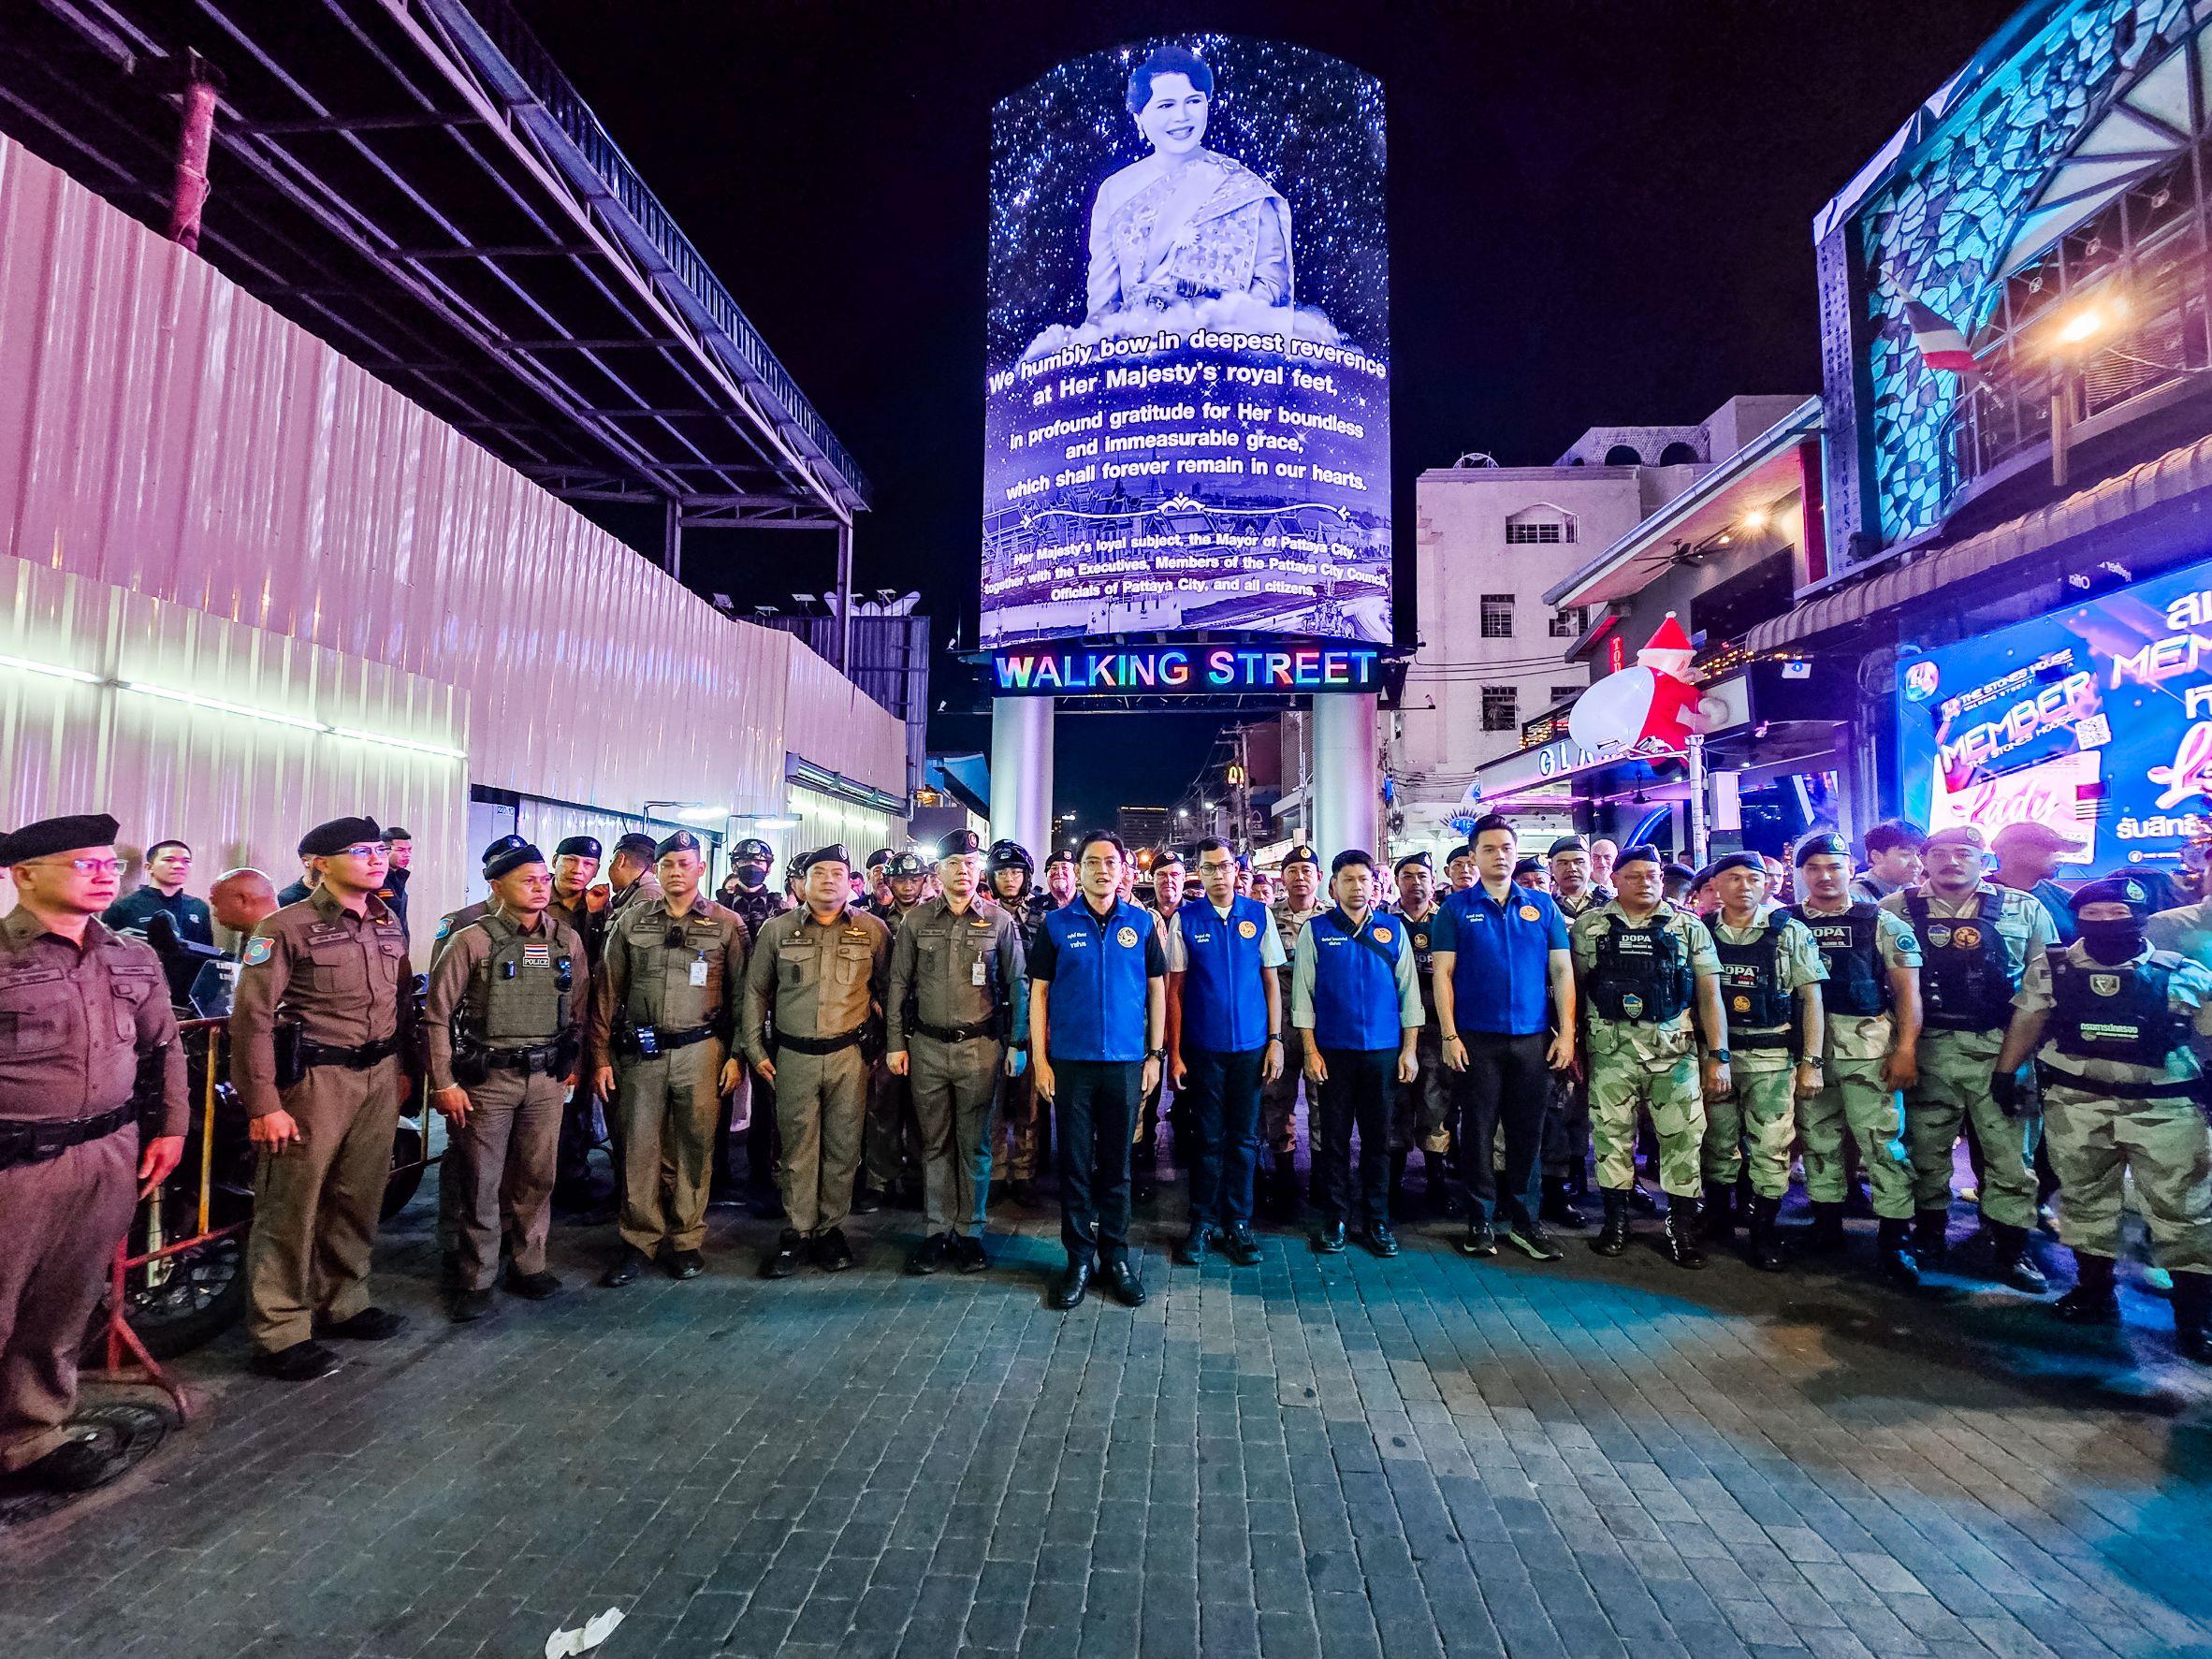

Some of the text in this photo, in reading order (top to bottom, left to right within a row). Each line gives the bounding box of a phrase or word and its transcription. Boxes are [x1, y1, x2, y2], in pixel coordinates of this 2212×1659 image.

[988, 328, 1388, 395] We humbly bow in deepest reverence
[1032, 362, 1338, 406] at Her Majesty's royal feet,
[1010, 402, 1364, 450] in profound gratitude for Her boundless
[1065, 429, 1304, 459] and immeasurable grace,
[1006, 456, 1368, 501] which shall forever remain in our hearts.
[1013, 533, 1358, 567] Her Majesty's loyal subject, the Mayor of Pattaya City,
[983, 575, 1026, 595] together
[1028, 569, 1052, 584] with
[1055, 566, 1075, 580] the
[1078, 559, 1151, 576] Executives,
[1156, 556, 1220, 570] Members
[1224, 556, 1238, 569] of
[1243, 557, 1265, 570] the
[1269, 558, 1317, 576] Pattaya
[1320, 563, 1345, 580] City
[1051, 584, 1100, 602] Officials
[1104, 582, 1119, 595] of
[1123, 579, 1173, 594] Pattaya
[1214, 578, 1240, 591] and
[1244, 578, 1260, 592] all
[996, 650, 1378, 688] WALKING STREET
[1983, 668, 2029, 692] STONES
[2029, 648, 2074, 674] HOUSE
[1941, 671, 2091, 774] MEMBER
[1967, 711, 2076, 769] THE STONES HOUSE
[1812, 927, 1846, 937] OPA
[1724, 966, 1755, 977] OPA
